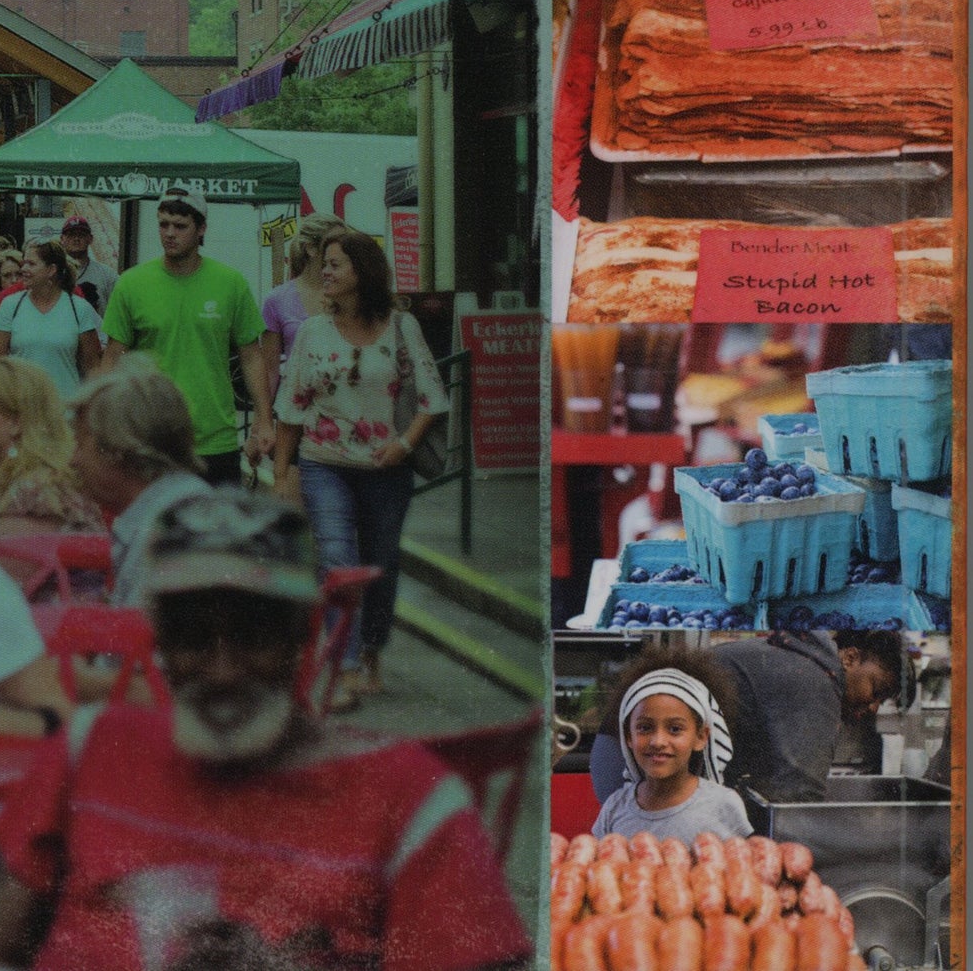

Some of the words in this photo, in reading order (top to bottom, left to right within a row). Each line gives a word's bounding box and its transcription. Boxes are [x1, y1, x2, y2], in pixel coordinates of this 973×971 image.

[14, 174, 124, 192] FINDLAY
[148, 177, 259, 196] MARKET
[722, 272, 818, 296] Stupid
[829, 273, 875, 288] Hot
[754, 299, 842, 315] Bacon
